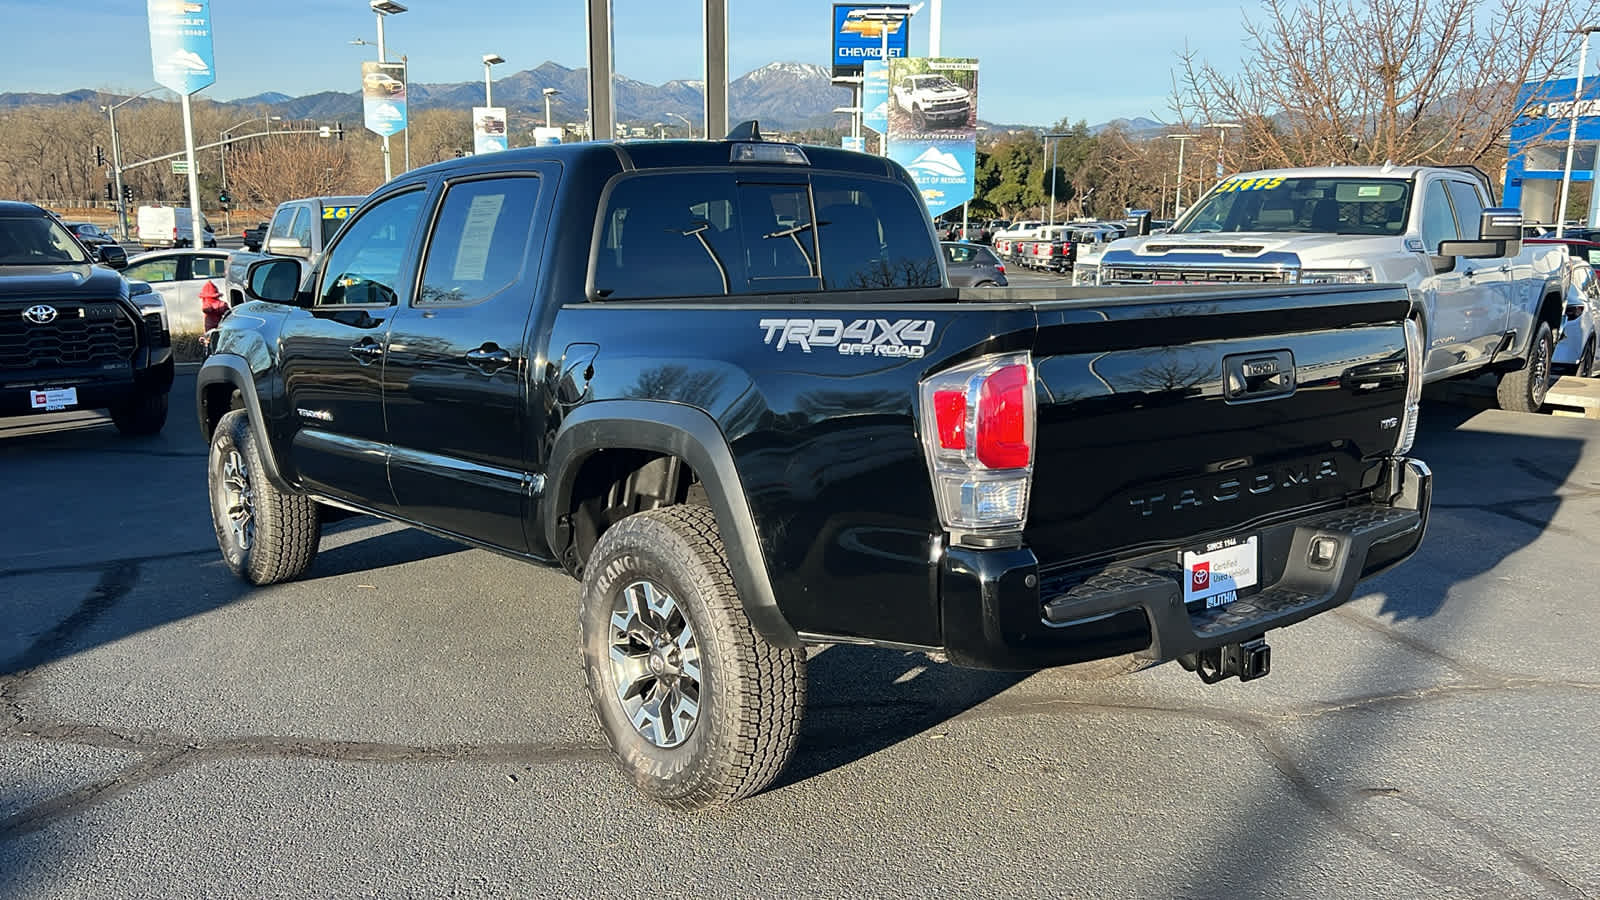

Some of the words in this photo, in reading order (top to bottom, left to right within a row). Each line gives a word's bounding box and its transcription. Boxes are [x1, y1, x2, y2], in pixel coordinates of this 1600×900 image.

[839, 47, 902, 57] CHEVROET
[838, 343, 872, 356] OFF
[874, 345, 925, 358] ROAD
[1129, 458, 1338, 516] TACOMA
[1206, 541, 1223, 551] SINCE
[1213, 574, 1228, 583] Used
